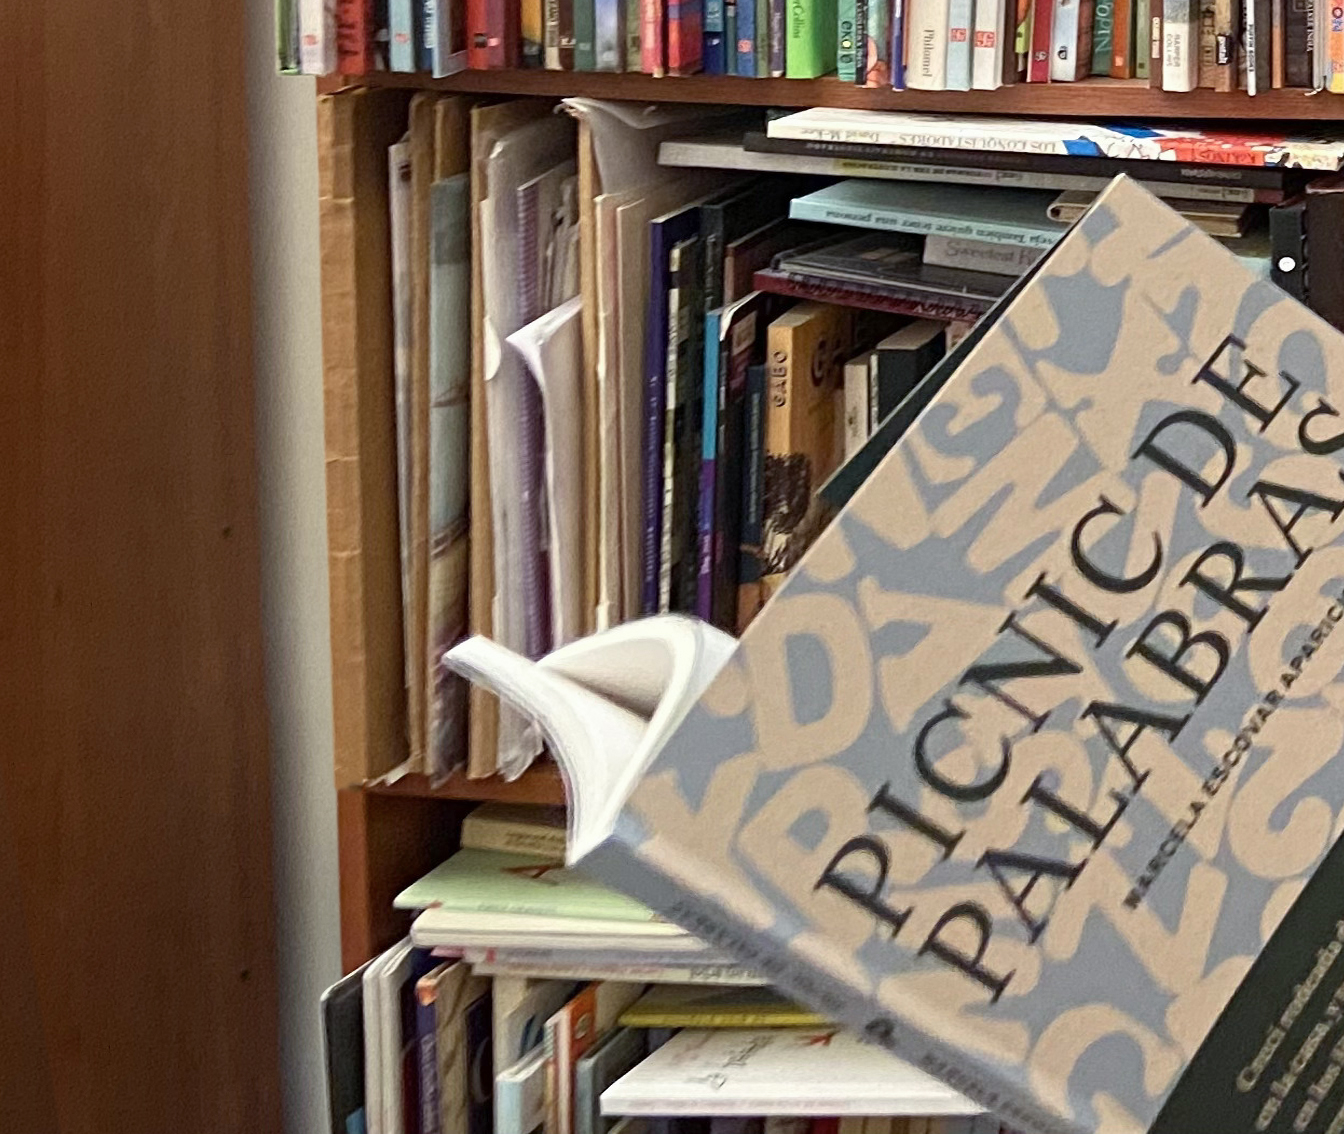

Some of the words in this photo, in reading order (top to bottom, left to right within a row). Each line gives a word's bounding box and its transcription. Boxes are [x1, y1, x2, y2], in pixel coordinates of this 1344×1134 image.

[919, 28, 934, 77] Philomel
[772, 350, 788, 408] GABO
[812, 492, 1166, 937] PICNIC
[1131, 333, 1302, 508] DE
[1122, 797, 1209, 912] MARCELA
[1202, 686, 1290, 797] ESCOVAR
